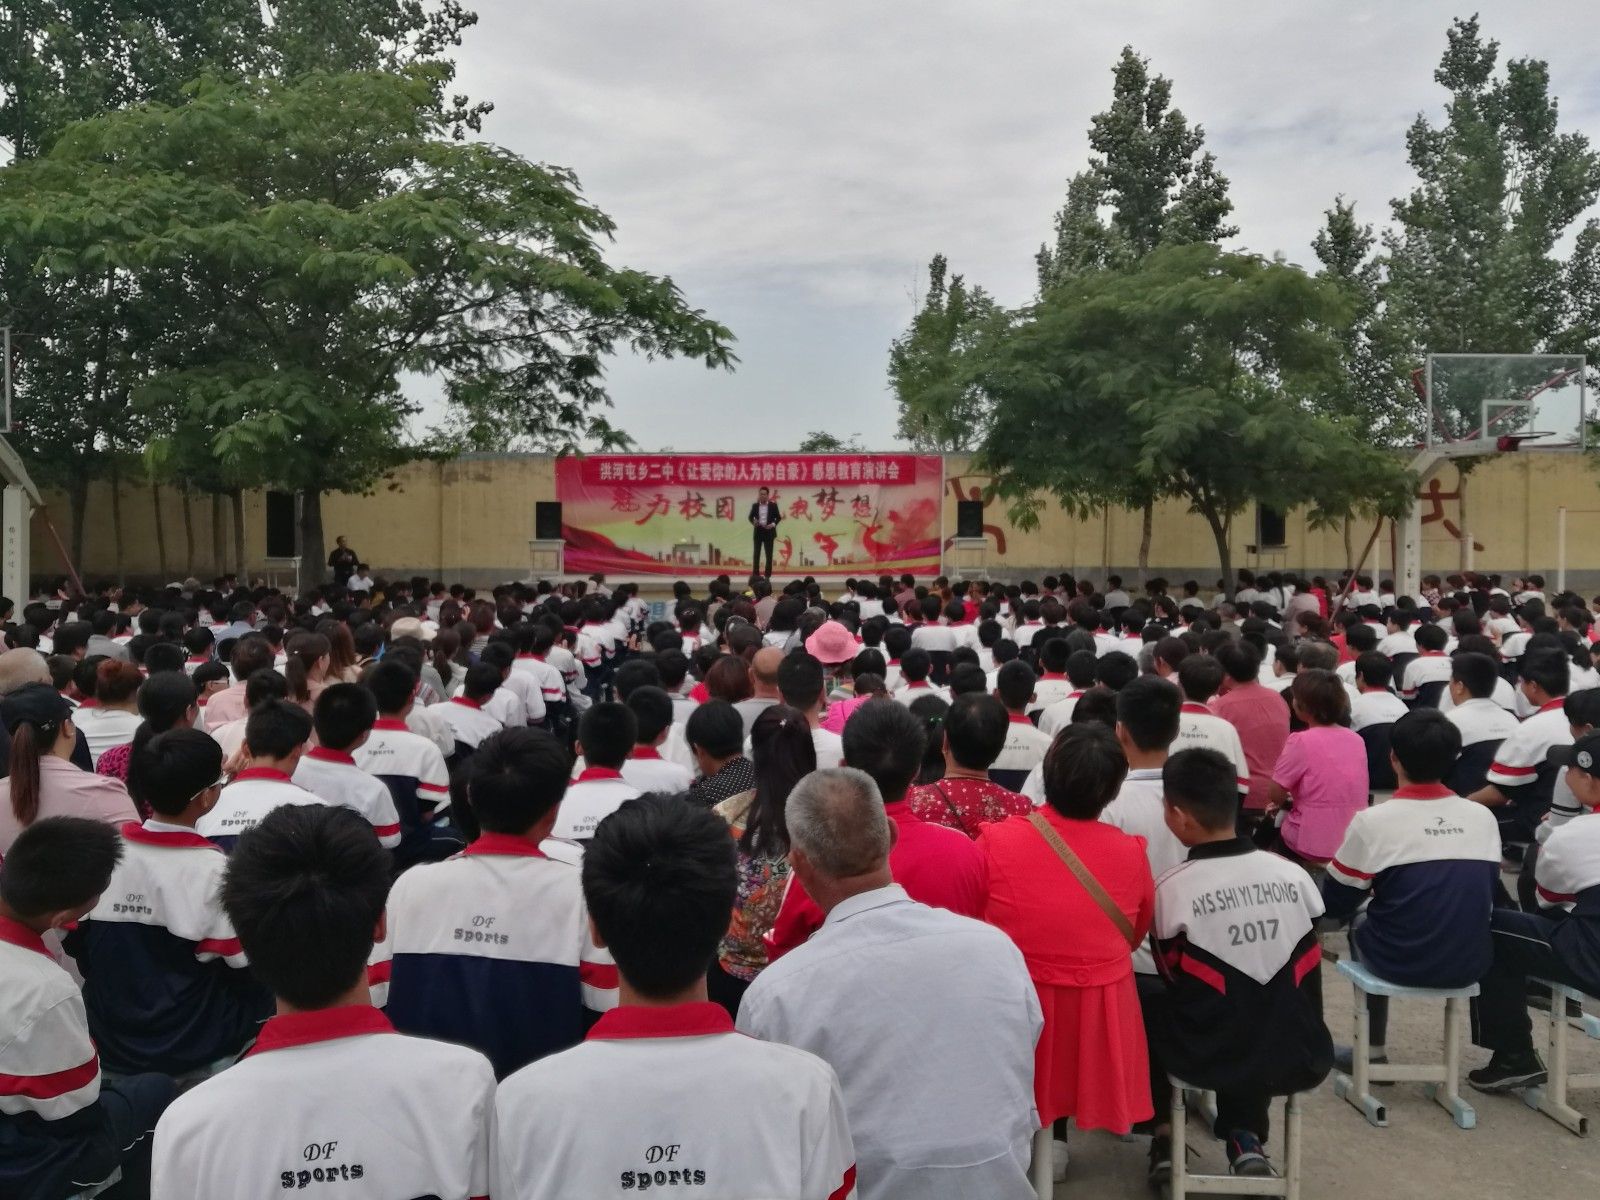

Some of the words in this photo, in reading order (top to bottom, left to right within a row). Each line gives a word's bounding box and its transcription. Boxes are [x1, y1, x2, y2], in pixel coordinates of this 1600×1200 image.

[221, 819, 257, 827] Sports
[113, 903, 153, 915] Sports
[1192, 893, 1216, 918] AYS
[1216, 887, 1240, 911] SHI
[1253, 882, 1299, 905] ZHONG
[472, 915, 496, 928] DF
[454, 928, 509, 944] Sports
[1228, 919, 1280, 946] 2017
[303, 1141, 338, 1161] DF
[645, 1144, 681, 1164] DF
[281, 1164, 364, 1189] Sports
[620, 1168, 706, 1191] Sports
